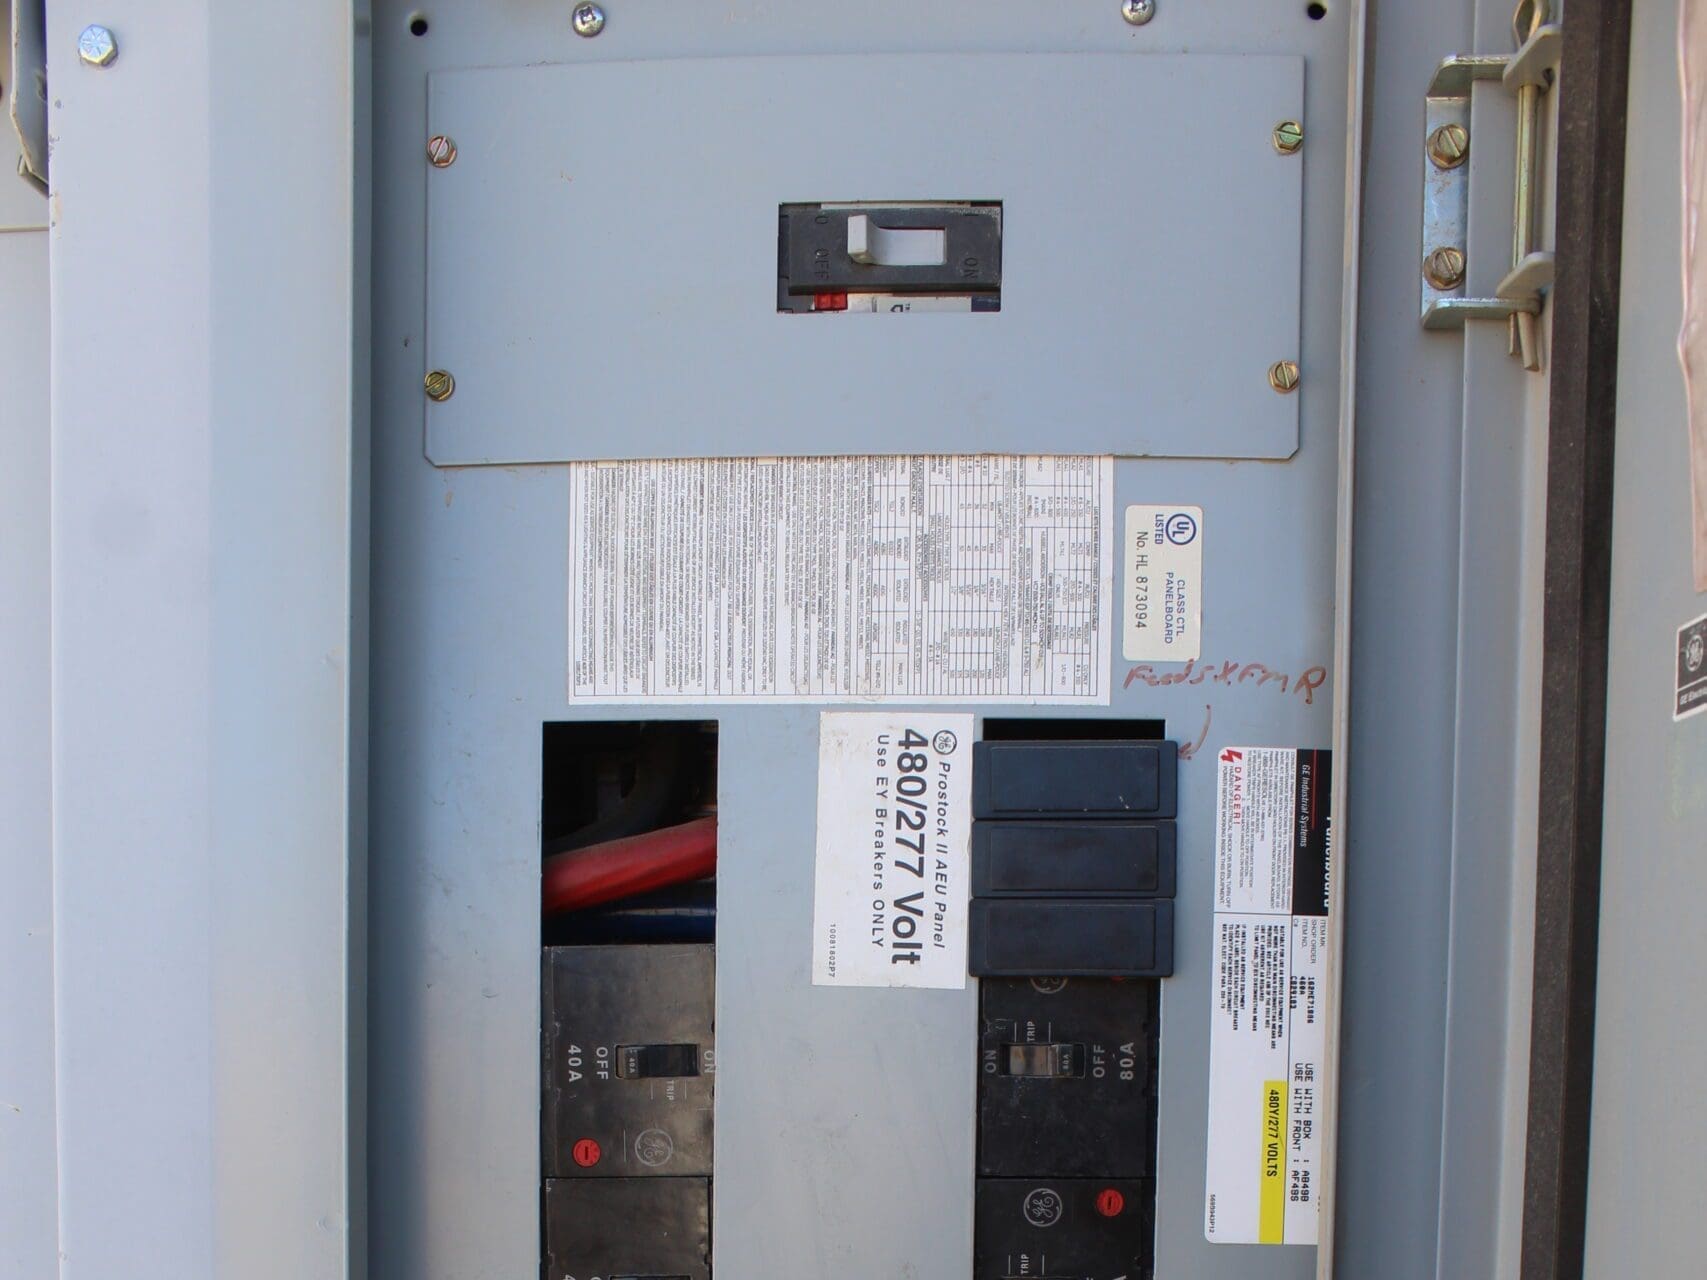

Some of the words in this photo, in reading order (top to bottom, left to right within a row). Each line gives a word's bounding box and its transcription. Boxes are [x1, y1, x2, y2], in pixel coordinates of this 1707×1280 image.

[815, 249, 829, 280] OFF
[964, 258, 977, 279] ON
[1136, 532, 1148, 550] No.
[1155, 514, 1163, 545] LISTED
[1136, 555, 1147, 570] HL
[1135, 576, 1147, 629] 873094
[1164, 572, 1173, 644] PANELBOARD
[1176, 580, 1185, 614] CLASS
[1176, 617, 1184, 636] CTL
[877, 734, 889, 767] Use
[1302, 765, 1310, 774] GE
[876, 777, 888, 798] EY
[936, 762, 950, 836] Prostock
[1301, 777, 1310, 813] Industrial
[895, 729, 928, 878] 480/277
[1300, 815, 1309, 847] Systems
[873, 809, 887, 890] Breakers
[935, 859, 947, 895] AEU
[872, 900, 884, 947] ONLY
[892, 892, 924, 965] Volt
[934, 902, 946, 948] Panel
[1027, 1022, 1035, 1042] TRIP
[568, 1045, 582, 1082] 40A
[596, 1047, 608, 1080] OFF
[704, 1051, 714, 1073] ON
[985, 1050, 997, 1073] ON
[1093, 1045, 1104, 1078] OFF
[1120, 1043, 1134, 1080] 80A
[1294, 1063, 1303, 1081] USE
[1304, 1063, 1313, 1082] USE
[666, 1080, 674, 1100] TRIP
[1294, 1088, 1302, 1114] WITH
[1304, 1089, 1312, 1114] WITH
[1268, 1089, 1279, 1138] 480Y/277
[1293, 1120, 1301, 1151] FRONT
[1303, 1120, 1311, 1139] BOX
[1267, 1143, 1278, 1177] VOLTS
[1021, 1254, 1029, 1274] TRIP
